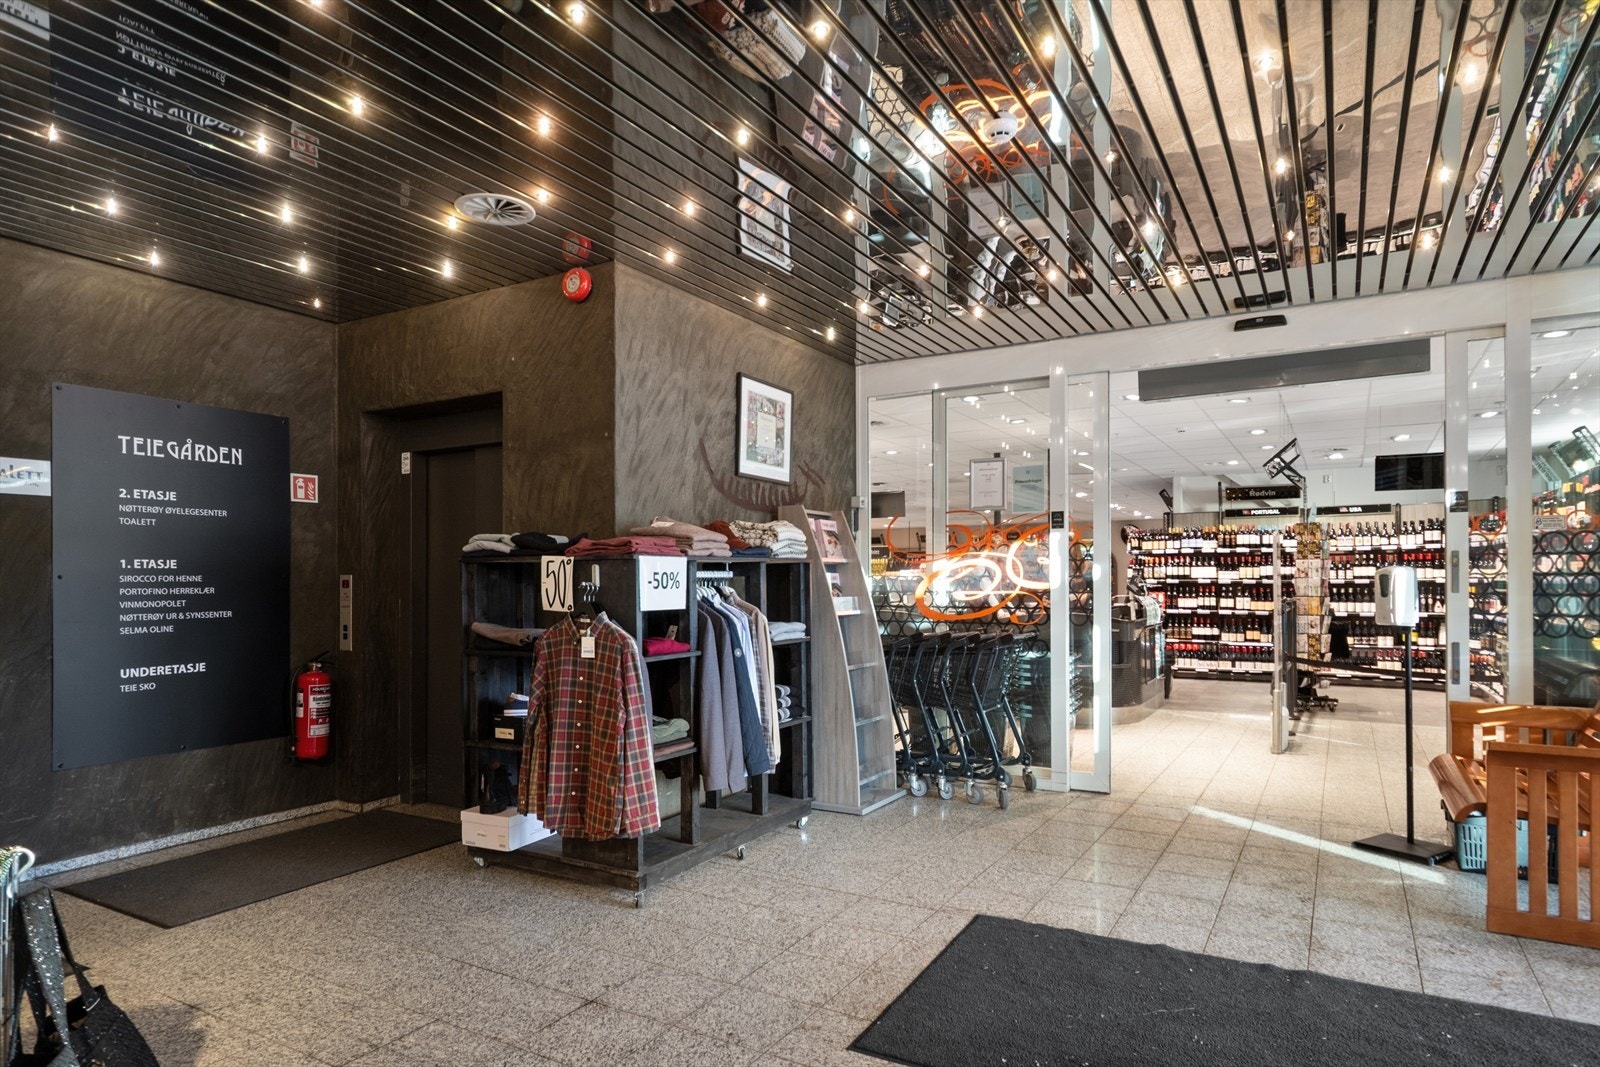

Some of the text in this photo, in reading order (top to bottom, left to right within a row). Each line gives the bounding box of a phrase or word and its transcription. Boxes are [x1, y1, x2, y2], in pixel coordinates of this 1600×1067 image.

[118, 435, 242, 466] TEIEGÅRDEN
[118, 488, 177, 501] 2. ETASJE
[119, 504, 228, 517] NØTTERØY ØYELEGESENTER
[119, 517, 156, 526] TOALETT
[120, 559, 178, 569] 1. ETASJE
[119, 575, 157, 583] SIROCCO
[176, 575, 203, 583] HENNE
[648, 571, 681, 590] -50%
[119, 587, 215, 596] PORTOFINO HERREKLÆR
[119, 600, 187, 609] VINMONOPOLET
[119, 611, 233, 622] NØTTERØY UR & SYNSSENTER
[119, 625, 175, 635] SELMA OLINE
[120, 662, 207, 679] UNDERETASJE
[120, 682, 156, 693] TEIE SKO
